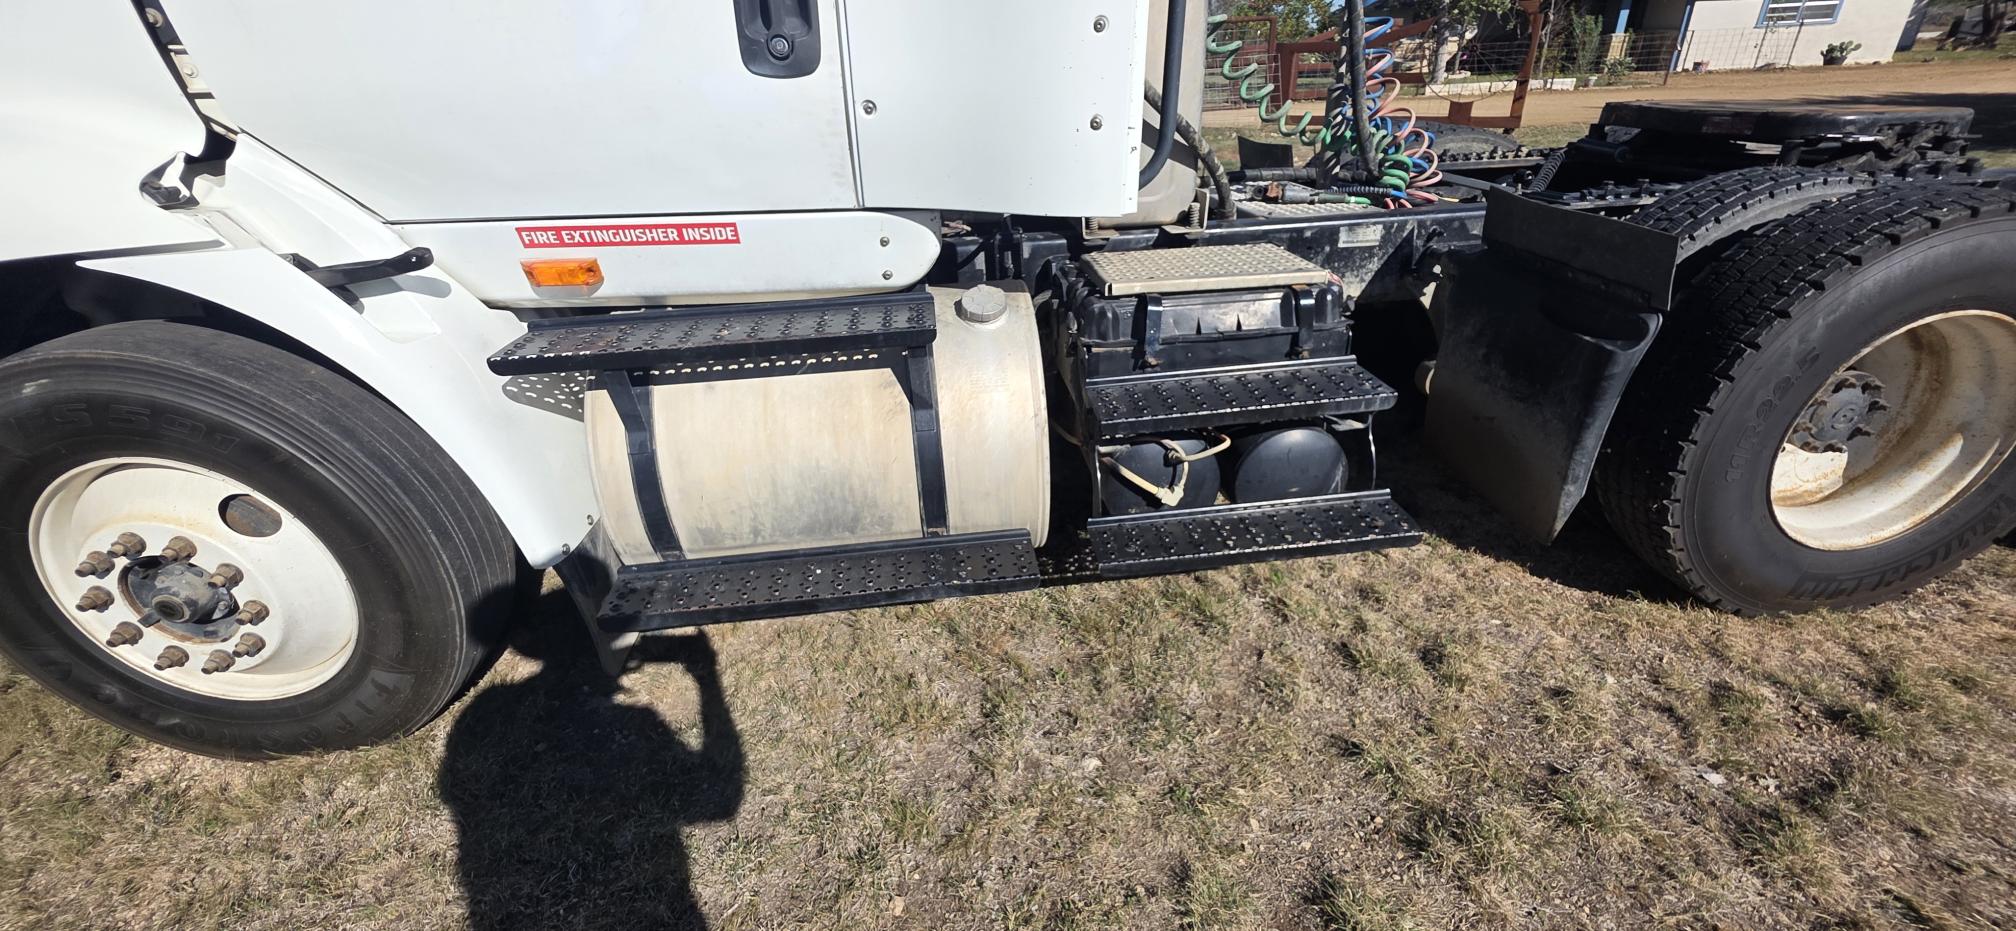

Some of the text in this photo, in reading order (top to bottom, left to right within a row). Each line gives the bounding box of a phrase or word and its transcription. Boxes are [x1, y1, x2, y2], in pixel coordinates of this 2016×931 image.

[521, 226, 738, 244] FIRE EXTINGUISHER INSIDE
